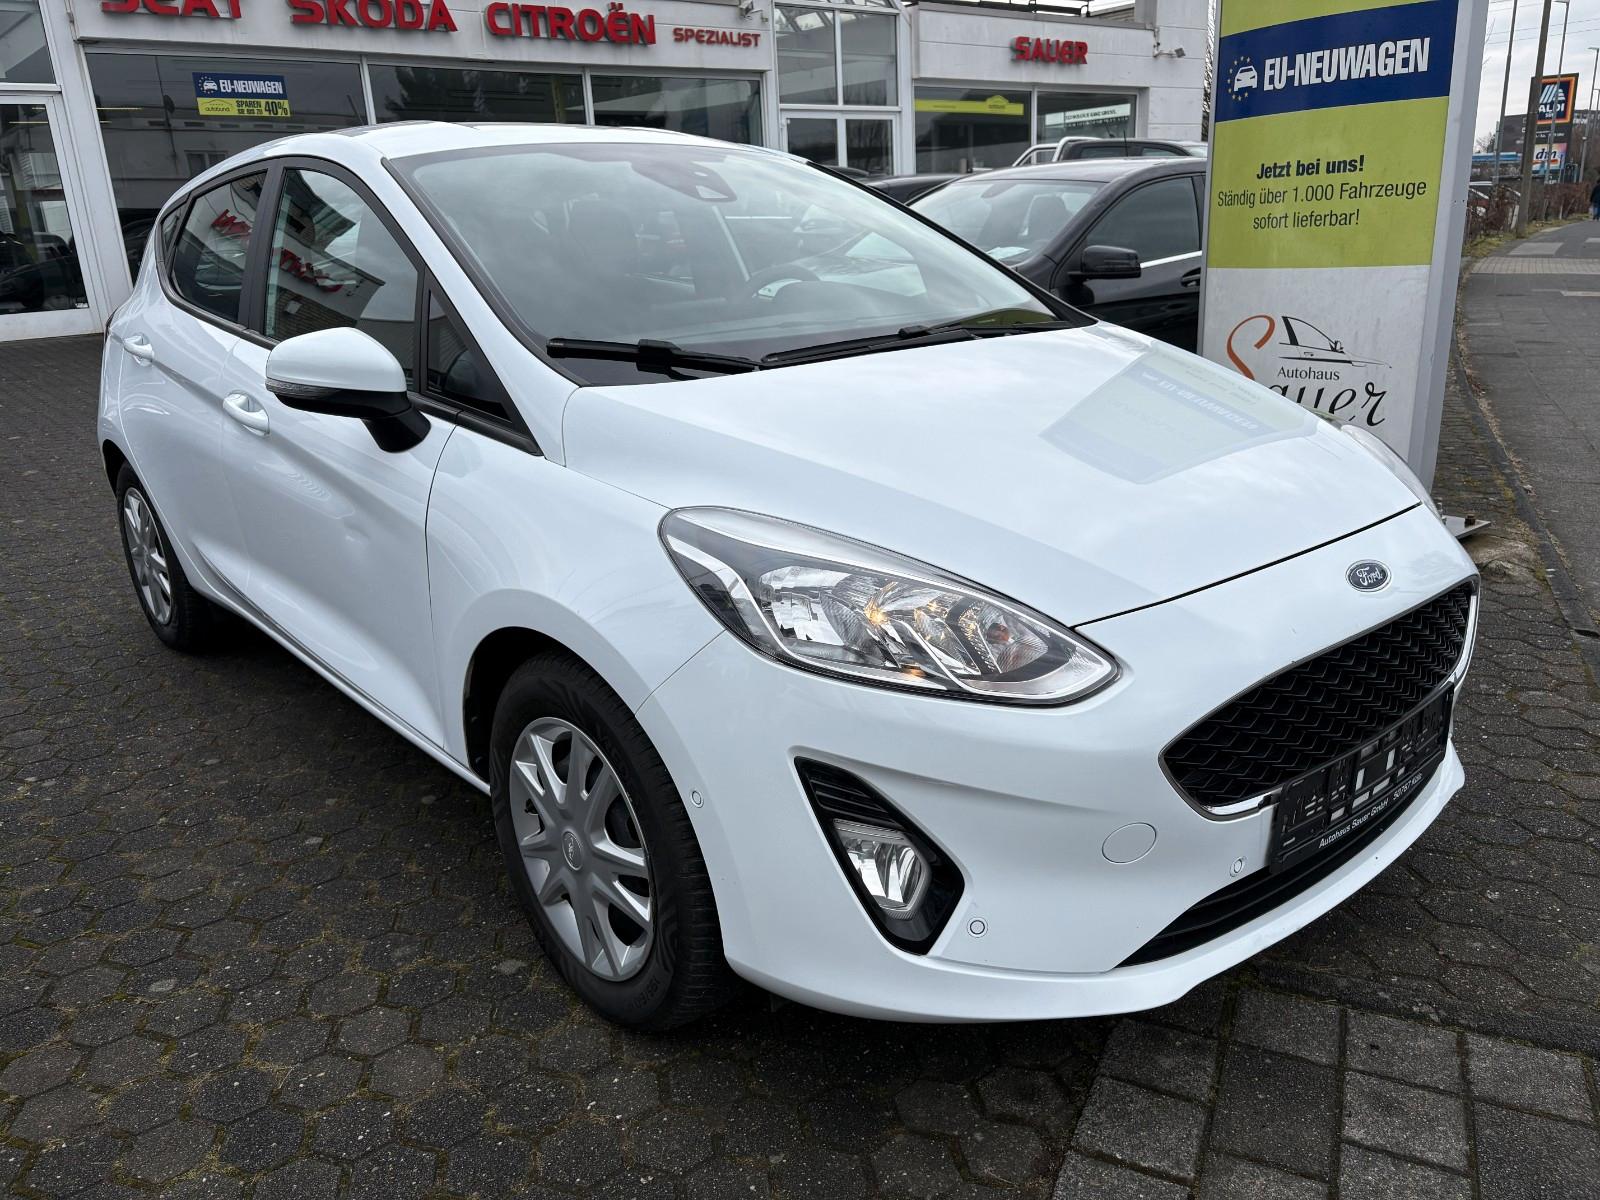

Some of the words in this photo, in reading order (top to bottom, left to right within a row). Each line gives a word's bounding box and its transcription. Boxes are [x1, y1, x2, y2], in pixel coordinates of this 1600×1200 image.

[487, 2, 656, 45] CITROËN
[673, 27, 760, 47] SPEZIALIST
[1013, 36, 1088, 64] SAUER
[1264, 37, 1430, 91] EU-NEUWAGEN
[219, 79, 283, 94] EU-NEUWAGEN
[236, 100, 262, 108] SPAREN
[264, 101, 288, 115] 40%
[1256, 161, 1291, 179] Jetzt
[1296, 158, 1320, 176] bei
[1325, 155, 1365, 174] uns!
[1217, 189, 1255, 208] Ständig
[1259, 188, 1287, 204] über
[1293, 184, 1334, 202] 1.000
[1340, 181, 1427, 199] Fahrzeuge
[1253, 212, 1289, 229] sofort
[1293, 209, 1360, 227] lieferbar!
[1277, 366, 1340, 380] Autohaus
[1356, 566, 1382, 586] Ford
[1319, 824, 1351, 848] Autohaus
[1351, 811, 1370, 828] Sauer
[1371, 798, 1389, 815] GmbH
